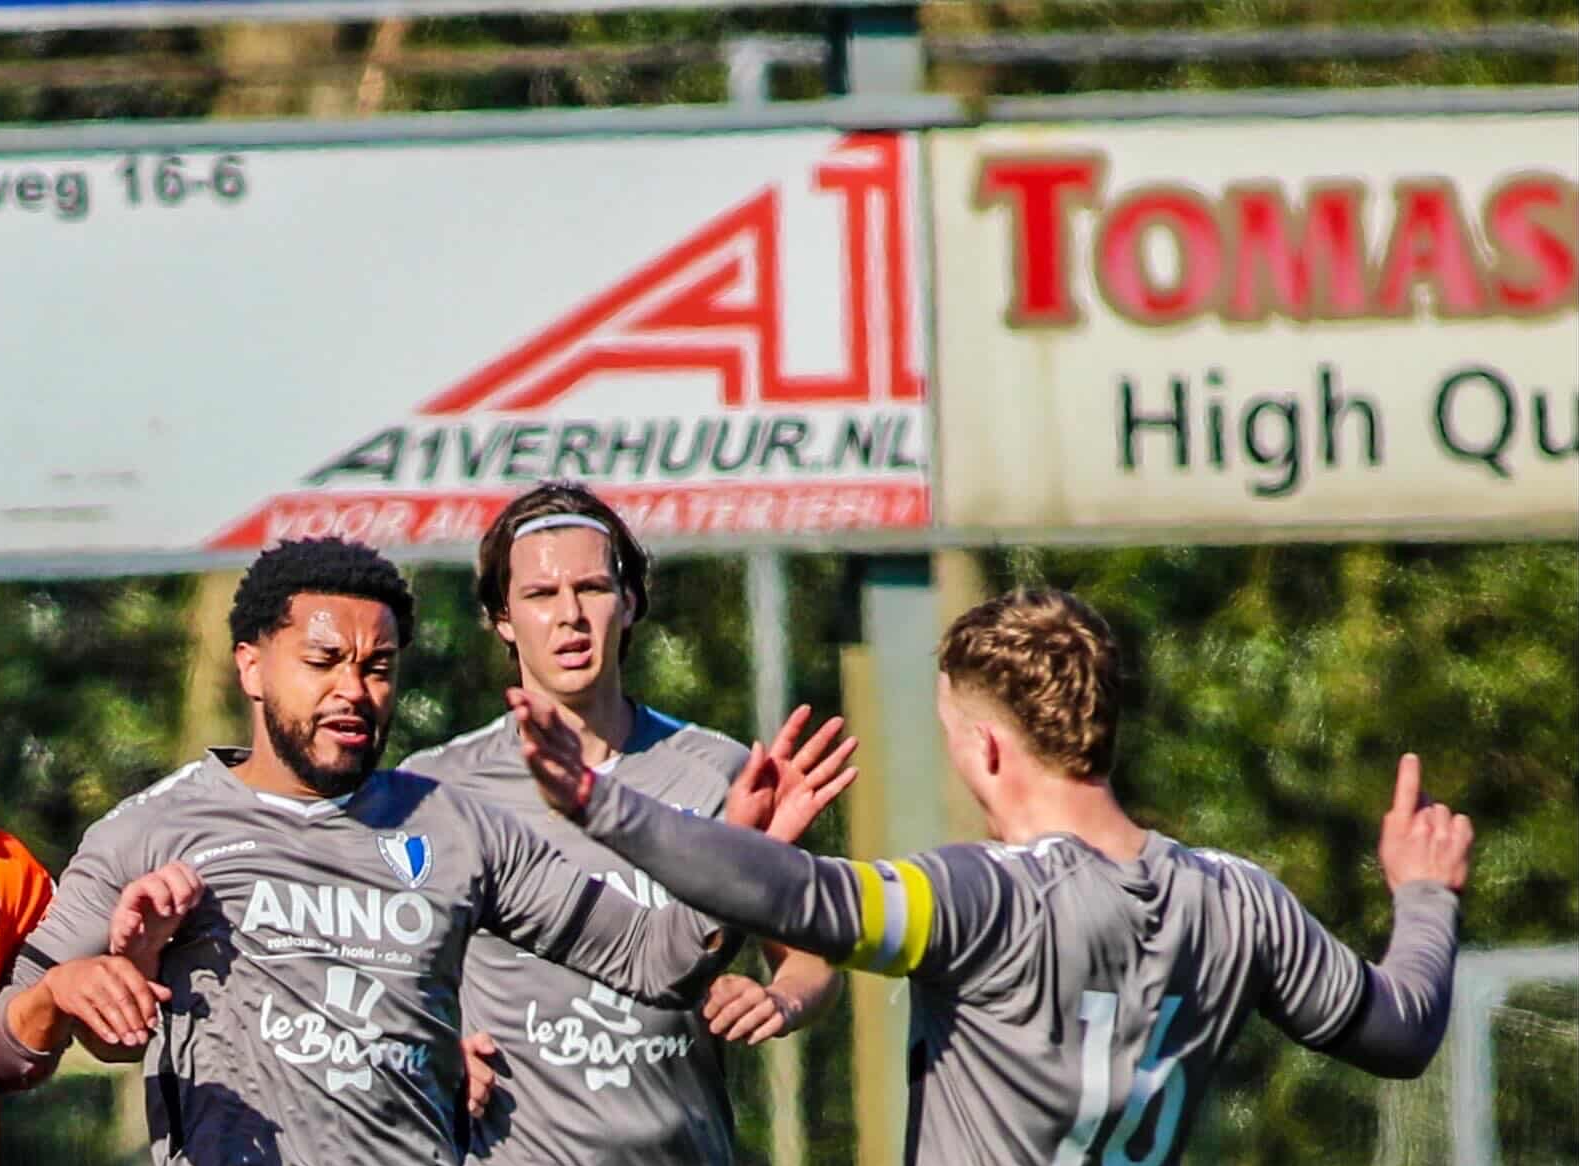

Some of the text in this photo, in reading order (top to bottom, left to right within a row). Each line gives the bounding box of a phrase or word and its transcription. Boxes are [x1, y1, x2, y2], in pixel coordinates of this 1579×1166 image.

[120, 153, 247, 203] 16-6
[300, 414, 926, 485] A1VERHUUR.NL
[1120, 366, 1382, 496] High
[241, 879, 434, 945] ANNO
